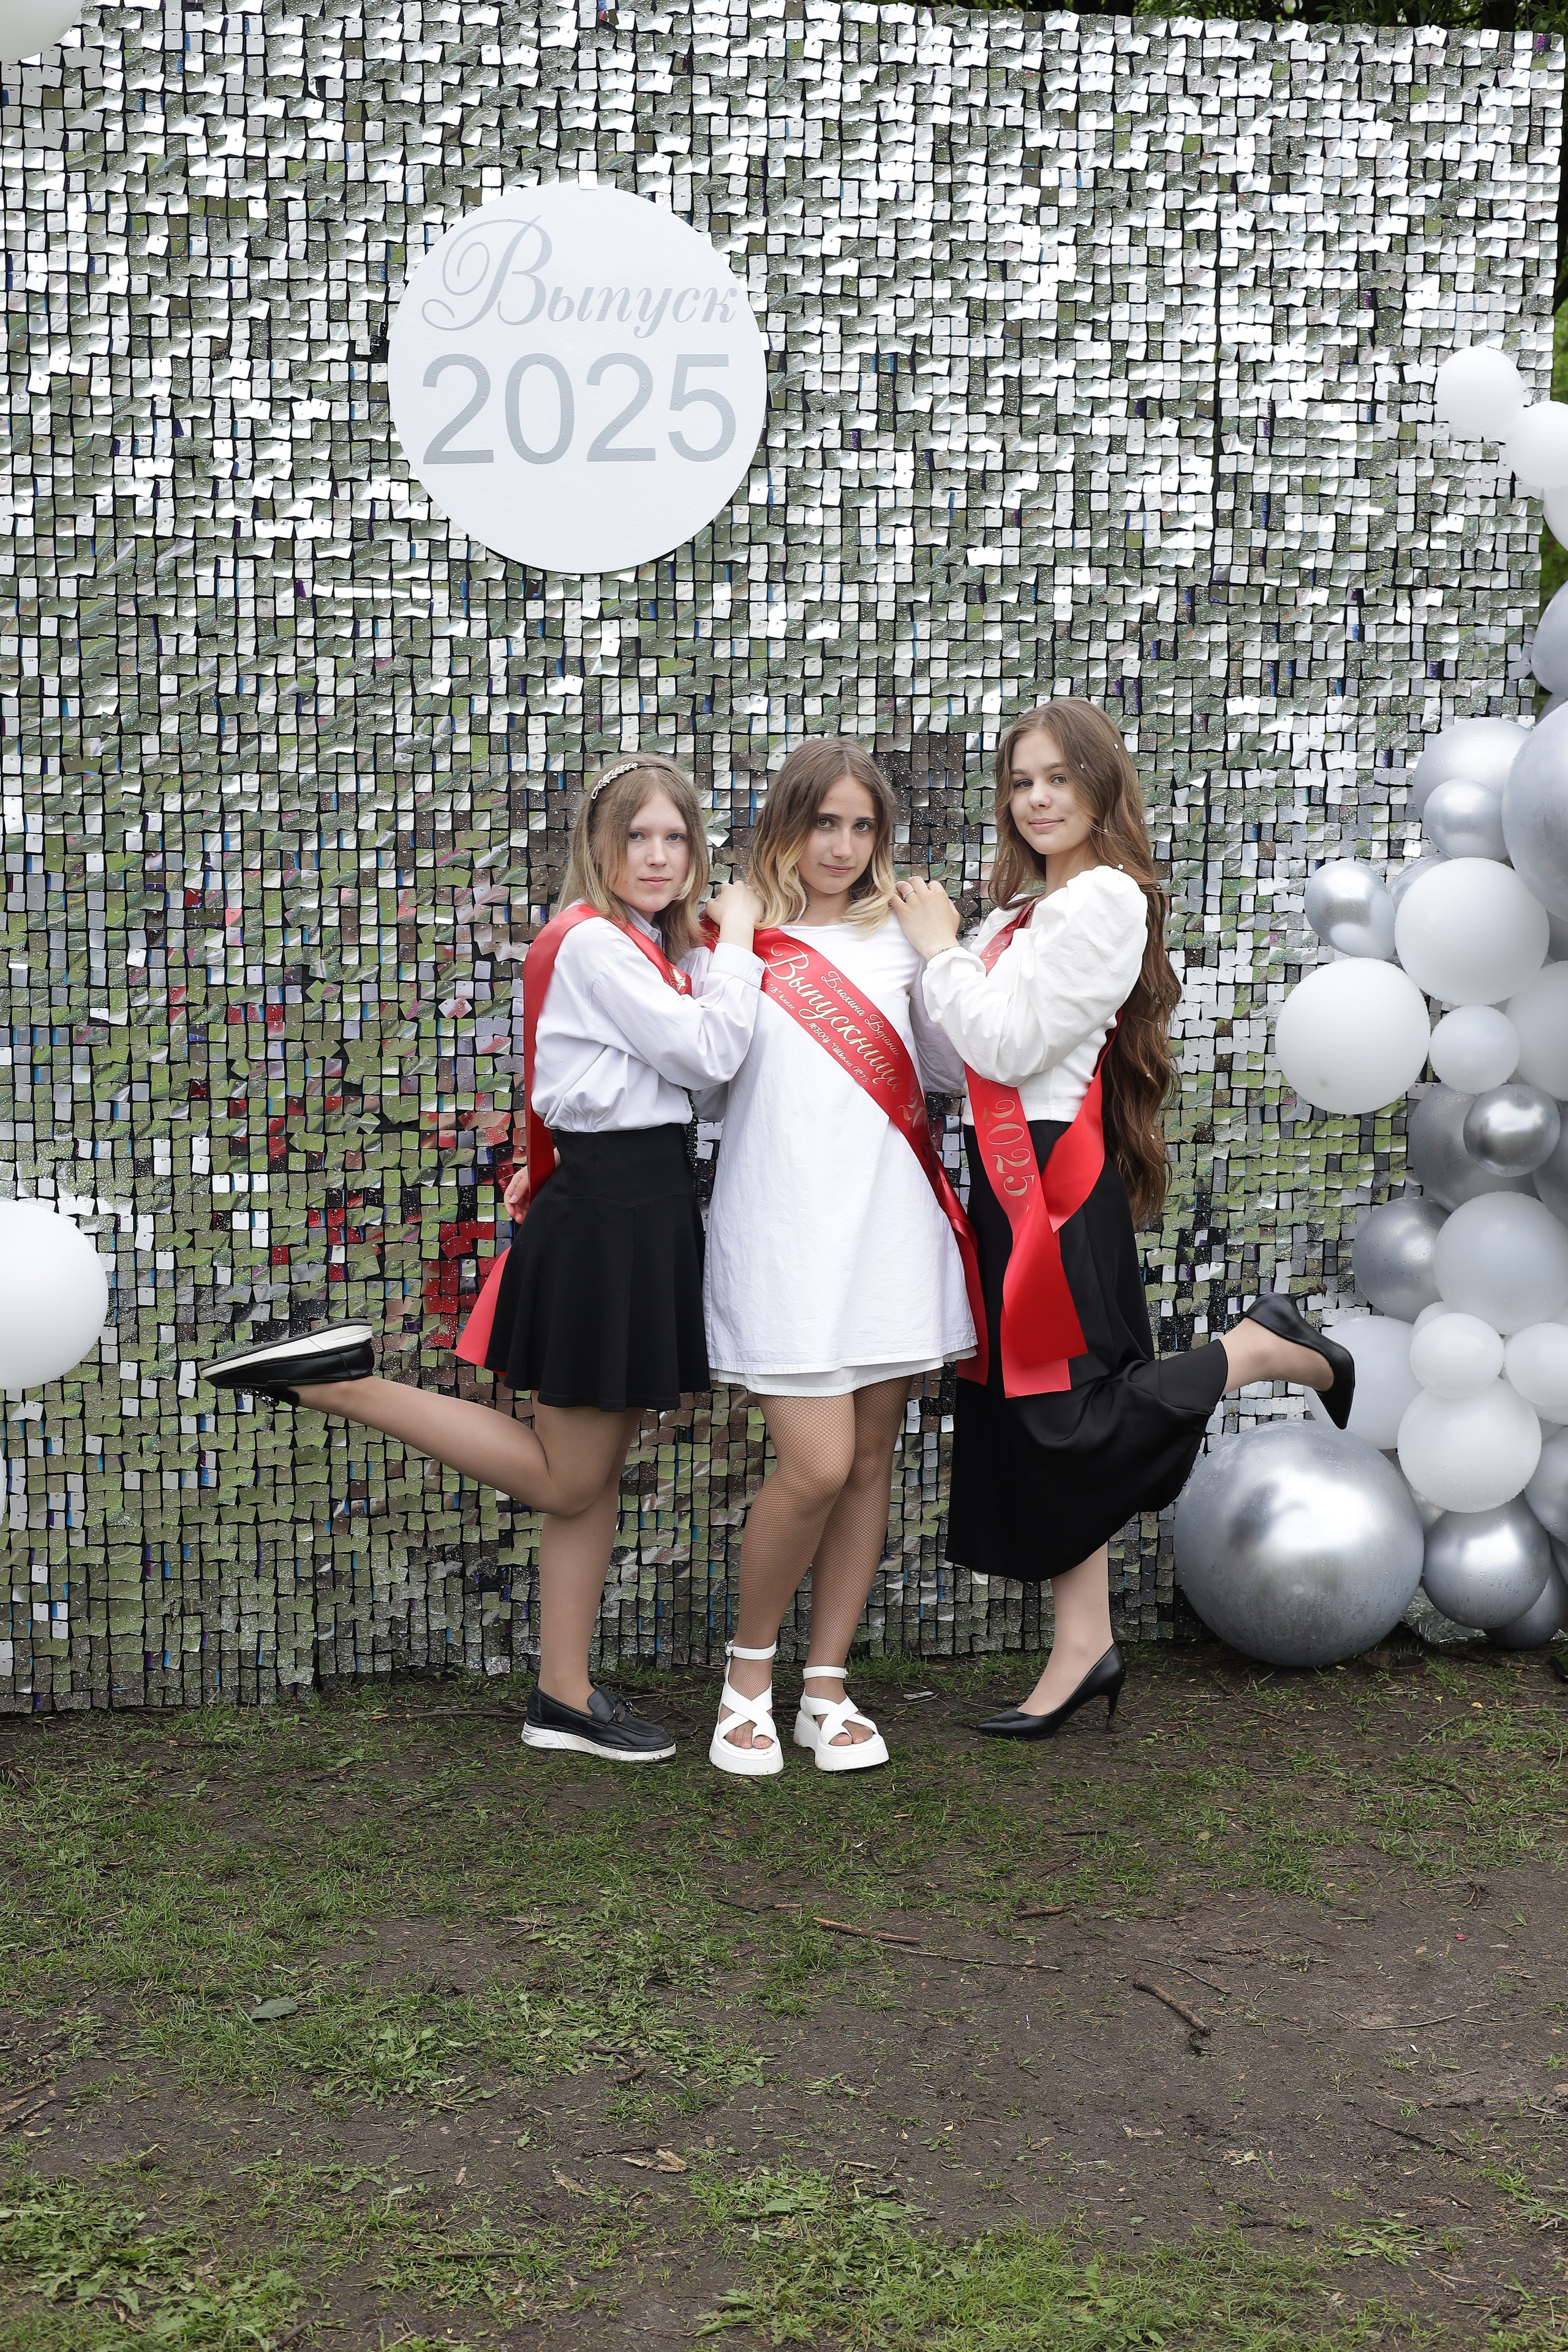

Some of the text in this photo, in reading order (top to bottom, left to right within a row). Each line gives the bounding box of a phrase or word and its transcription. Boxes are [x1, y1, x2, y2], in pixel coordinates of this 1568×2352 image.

[421, 214, 739, 339] Выпуск
[422, 352, 737, 466] 2025
[761, 942, 903, 1092] Выпускница
[778, 993, 796, 1011] класс
[805, 1022, 832, 1044] МБОУ
[820, 970, 865, 1017] Блохина
[982, 1099, 1035, 1197] 2025
